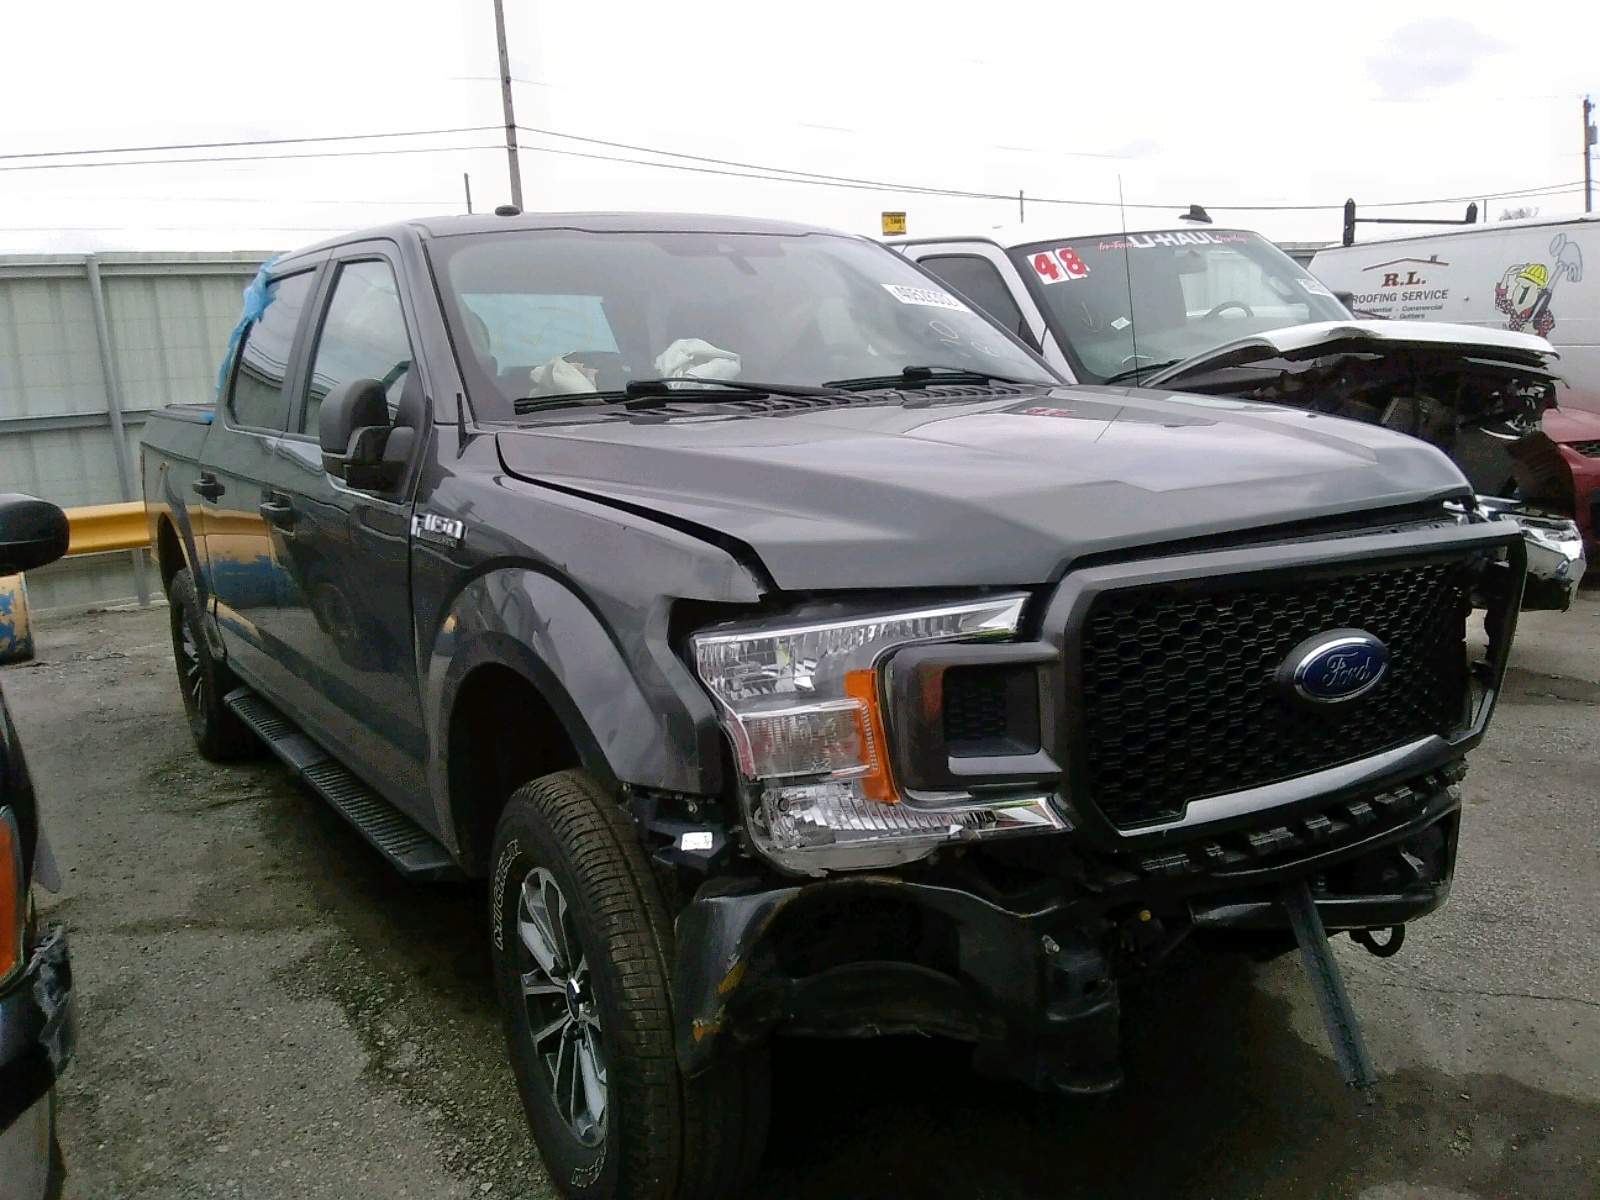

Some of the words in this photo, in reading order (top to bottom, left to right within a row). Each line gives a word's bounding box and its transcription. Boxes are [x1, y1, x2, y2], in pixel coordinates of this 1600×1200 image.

[1127, 231, 1223, 249] U-HAUL
[1034, 249, 1086, 280] 48
[1381, 271, 1427, 288] R.L.
[1353, 292, 1398, 305] ROOFING
[1401, 289, 1449, 302] SERVICE
[1402, 303, 1444, 312] Commercial
[1322, 652, 1371, 687] Ford
